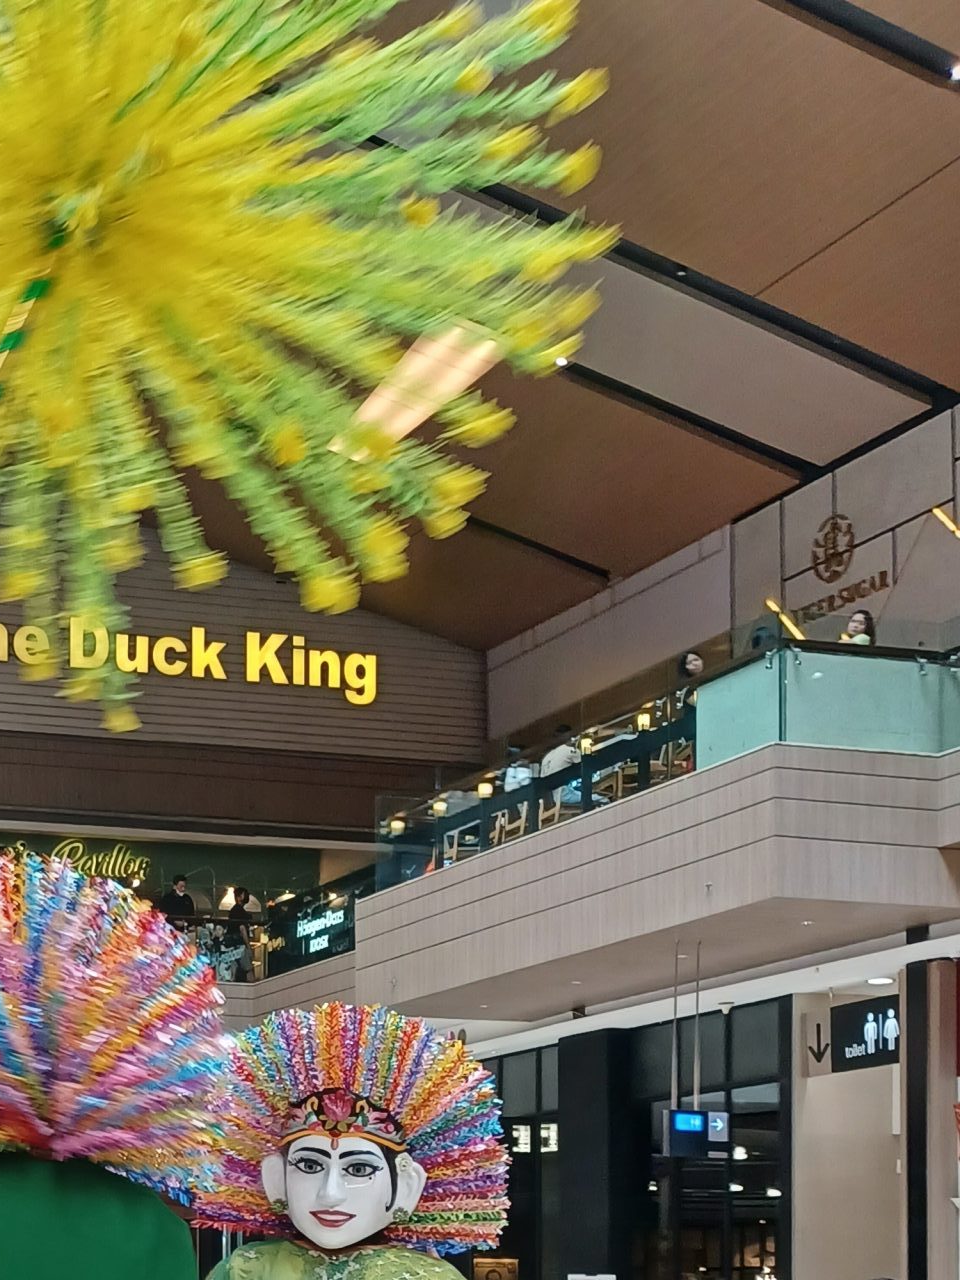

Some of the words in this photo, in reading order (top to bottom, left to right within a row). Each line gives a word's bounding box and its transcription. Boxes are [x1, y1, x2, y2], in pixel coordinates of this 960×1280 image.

[69, 615, 227, 681] Duck
[246, 631, 378, 706] King
[845, 1043, 866, 1059] toilet
